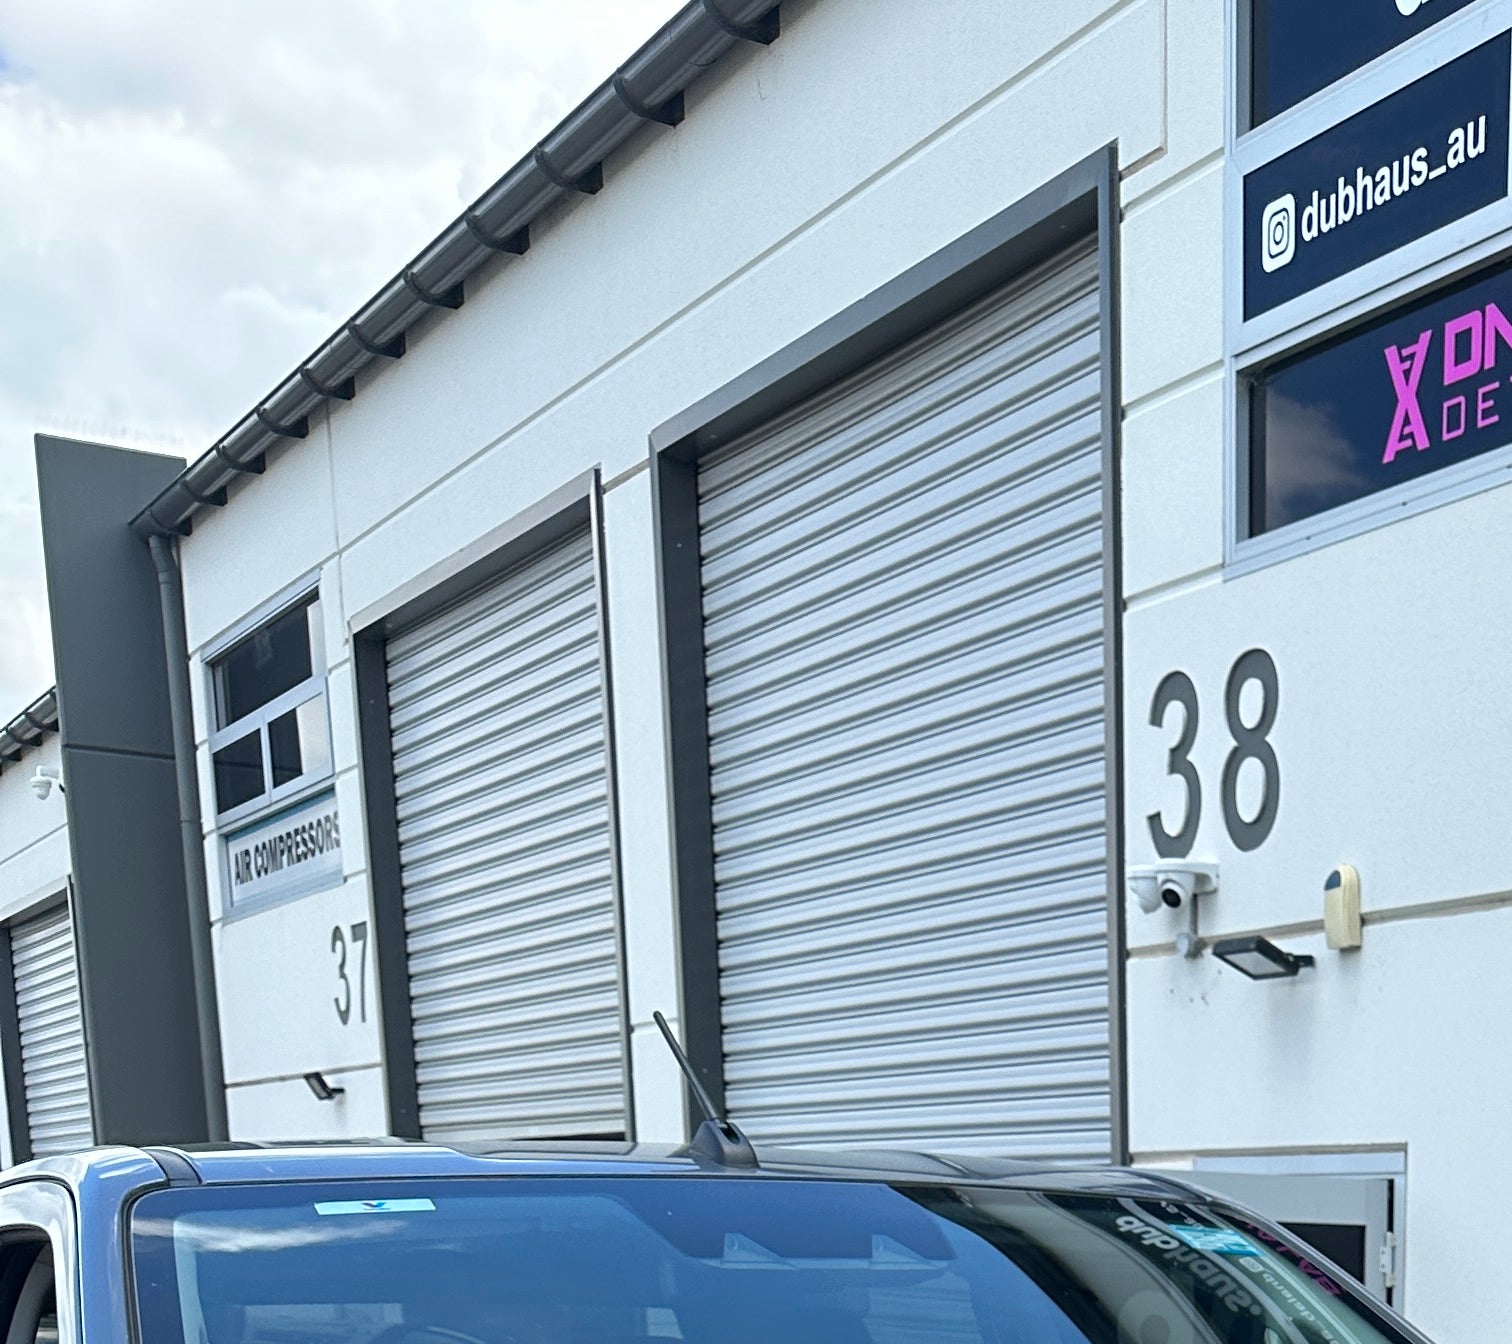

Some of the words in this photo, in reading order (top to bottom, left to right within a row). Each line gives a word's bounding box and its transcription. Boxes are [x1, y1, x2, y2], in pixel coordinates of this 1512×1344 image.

[1300, 114, 1487, 242] dubhaus_au
[1146, 647, 1280, 859] 38
[234, 848, 253, 886] AIR
[254, 812, 341, 878] COMPRESSORS
[330, 920, 368, 1027] 37
